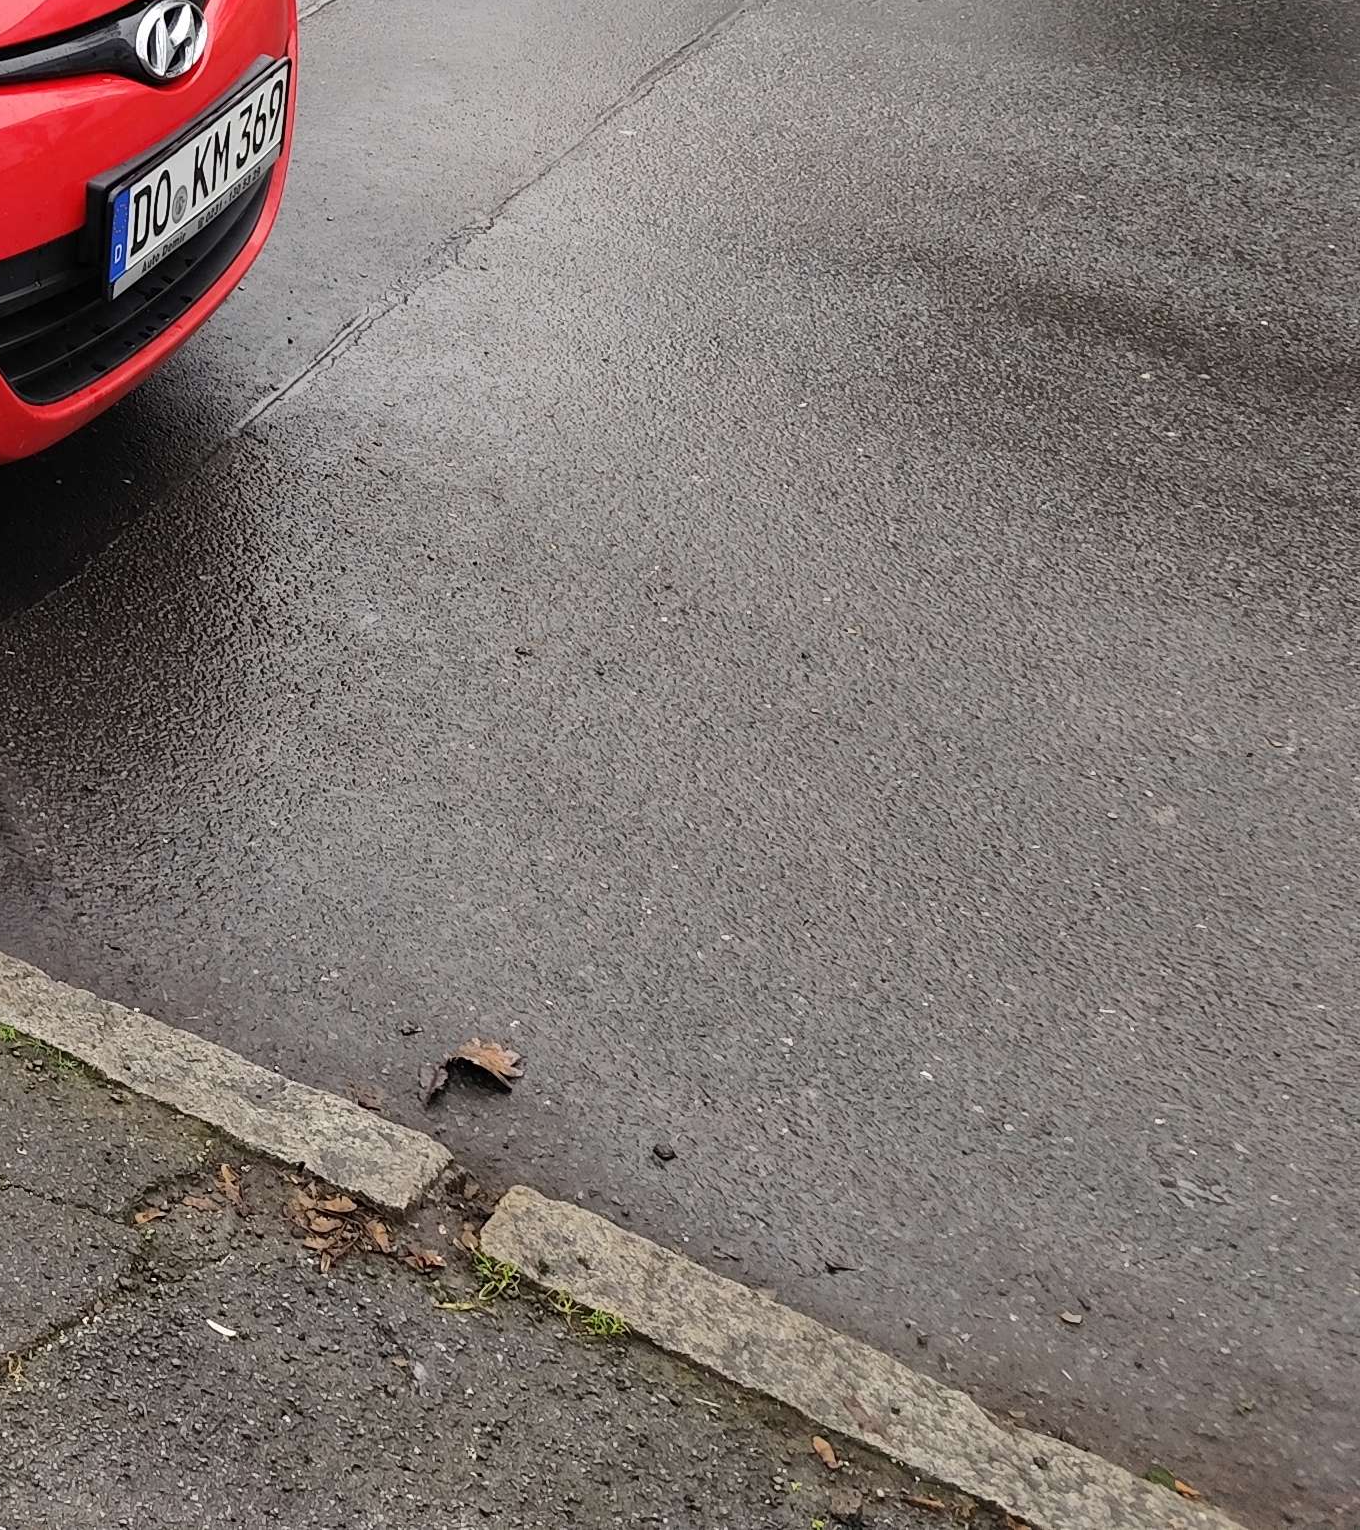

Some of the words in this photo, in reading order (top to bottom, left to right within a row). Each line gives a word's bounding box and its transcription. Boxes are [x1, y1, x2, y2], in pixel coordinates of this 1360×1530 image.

[130, 169, 171, 257] DO
[192, 120, 232, 208] KM
[236, 79, 284, 169] 369
[114, 245, 122, 264] D
[141, 253, 160, 273] Auto
